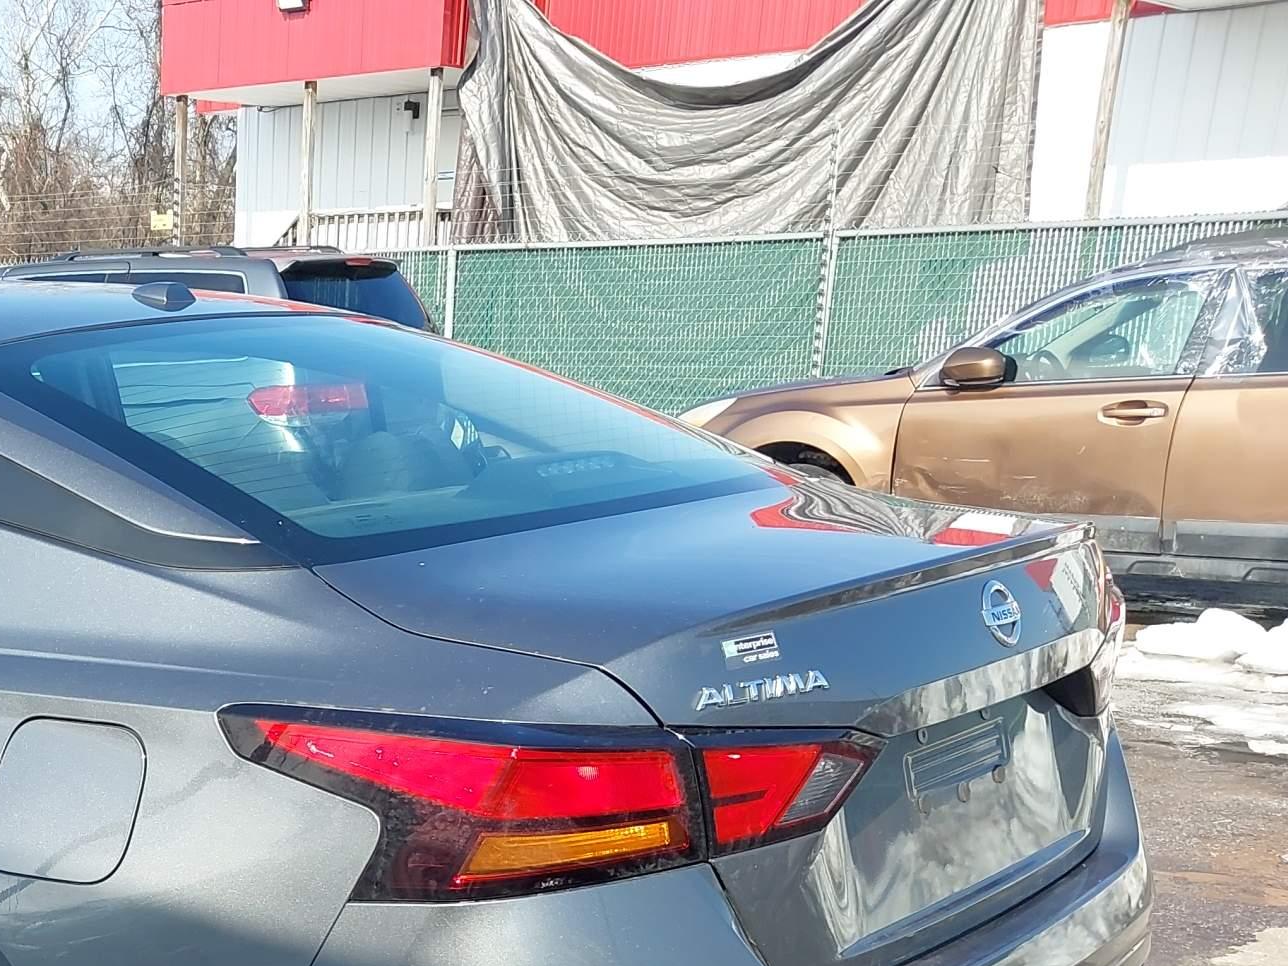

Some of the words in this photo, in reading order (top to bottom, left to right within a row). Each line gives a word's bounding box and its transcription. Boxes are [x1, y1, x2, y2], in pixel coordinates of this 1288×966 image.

[743, 654, 757, 663] car
[758, 649, 780, 660] sales
[695, 670, 830, 711] ALTIMA
